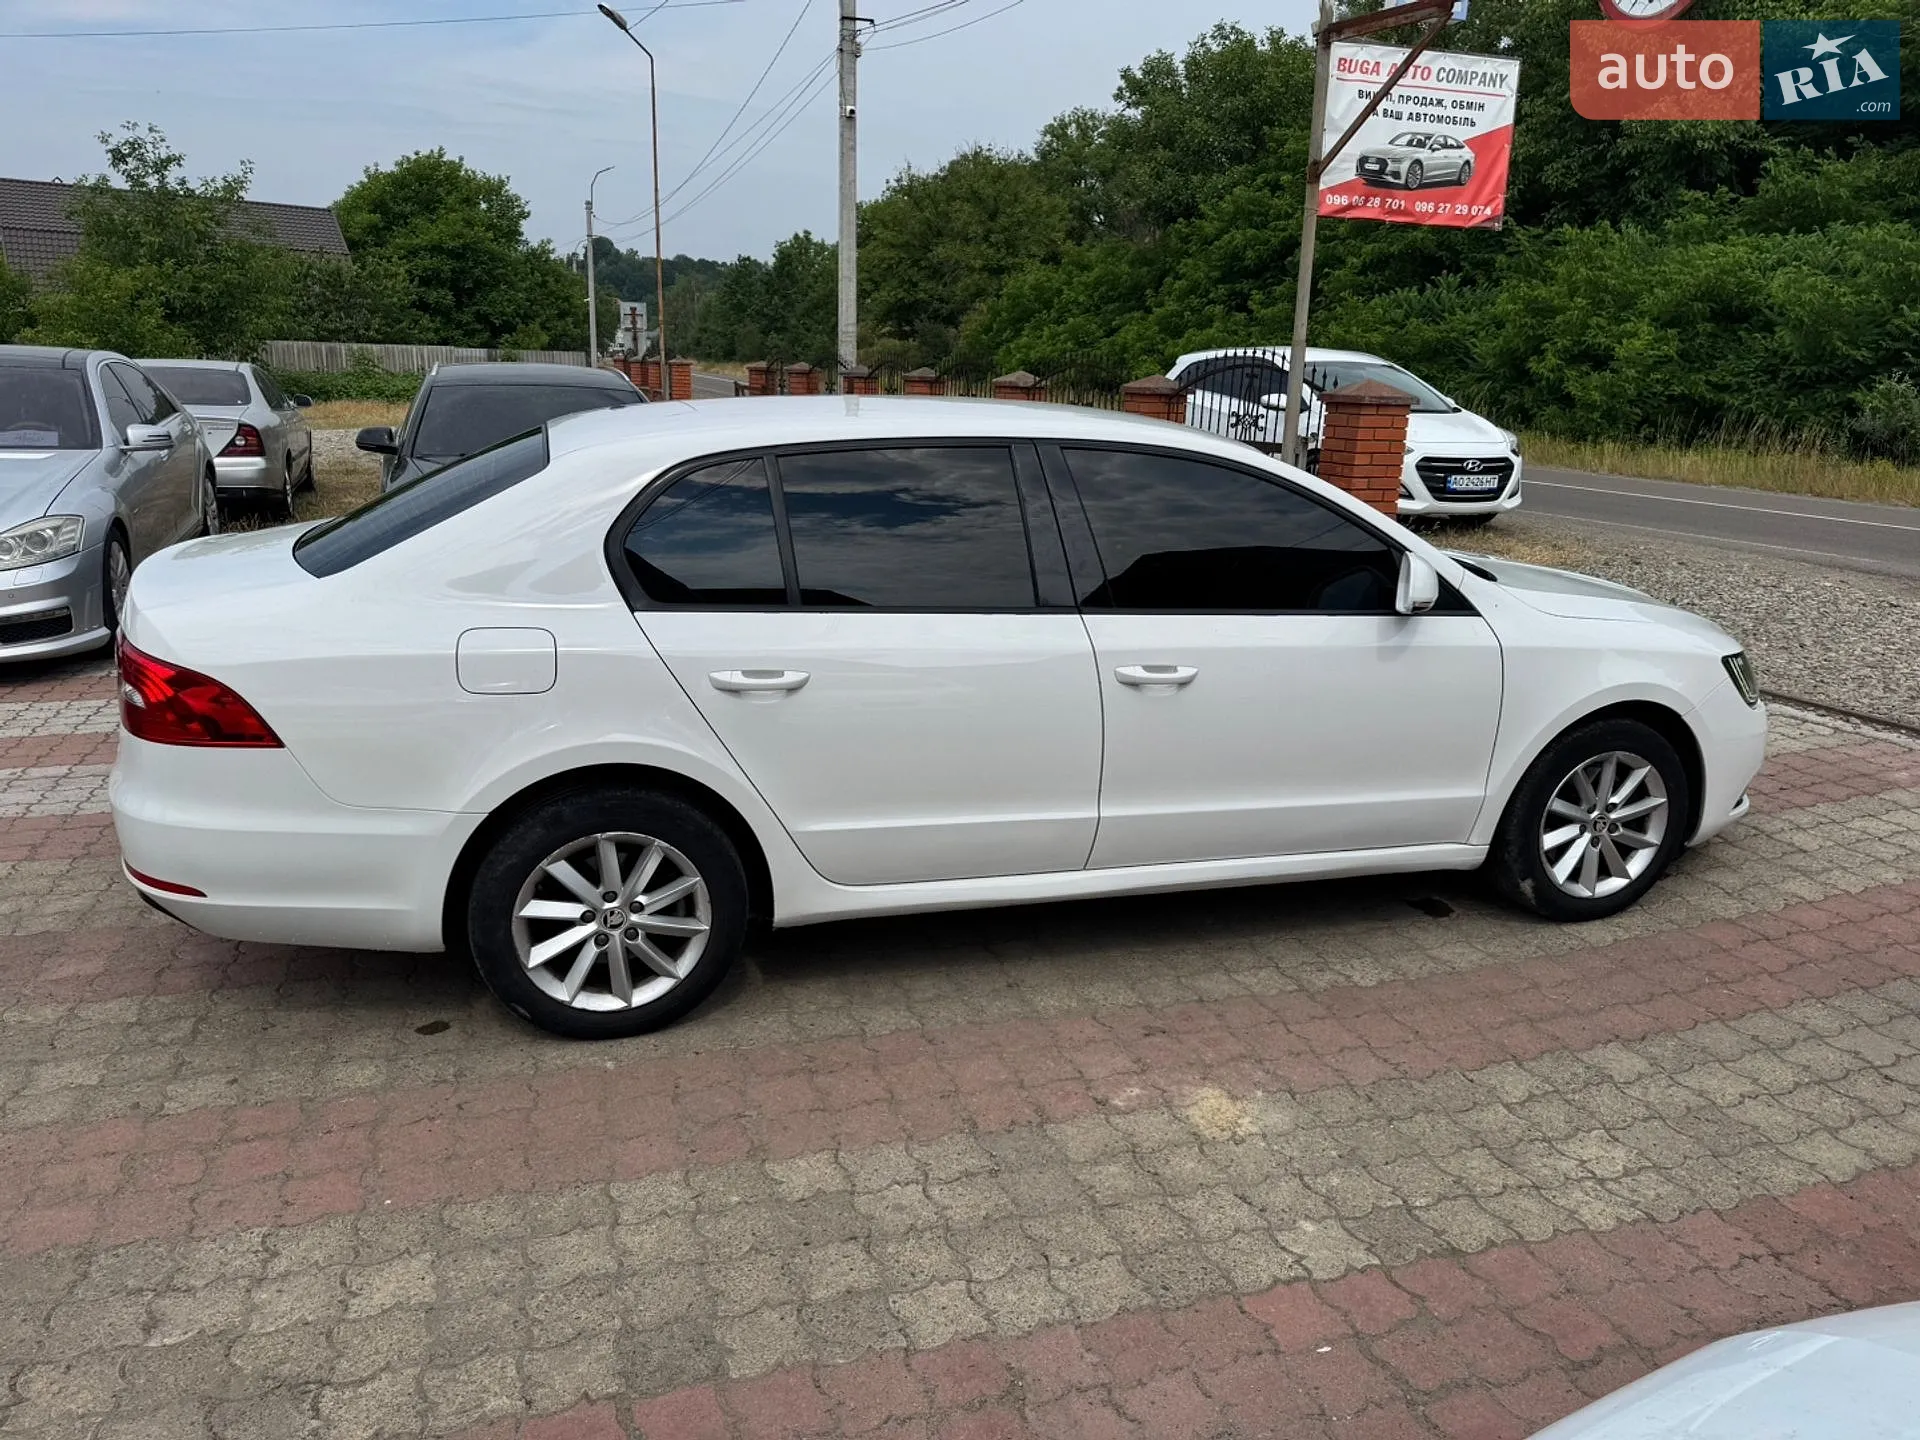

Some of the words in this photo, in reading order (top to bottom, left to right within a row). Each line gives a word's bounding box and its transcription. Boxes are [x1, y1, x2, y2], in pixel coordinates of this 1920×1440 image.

[1337, 57, 1381, 77] BUGA
[1387, 62, 1432, 81] ATO
[1436, 66, 1508, 89] COMPANY
[1398, 94, 1447, 110] ПРОДАЖ,
[1451, 100, 1485, 112] ОБМІН
[1382, 108, 1403, 121] ВАШ
[1406, 112, 1477, 128] АВТОМОБІЛЬ
[1325, 194, 1348, 206] 096
[1366, 196, 1381, 208] 28
[1385, 198, 1405, 210] 701
[1414, 201, 1435, 213] 096
[1437, 202, 1452, 213] 27
[1455, 203, 1468, 215] 29
[1471, 205, 1492, 217] 074
